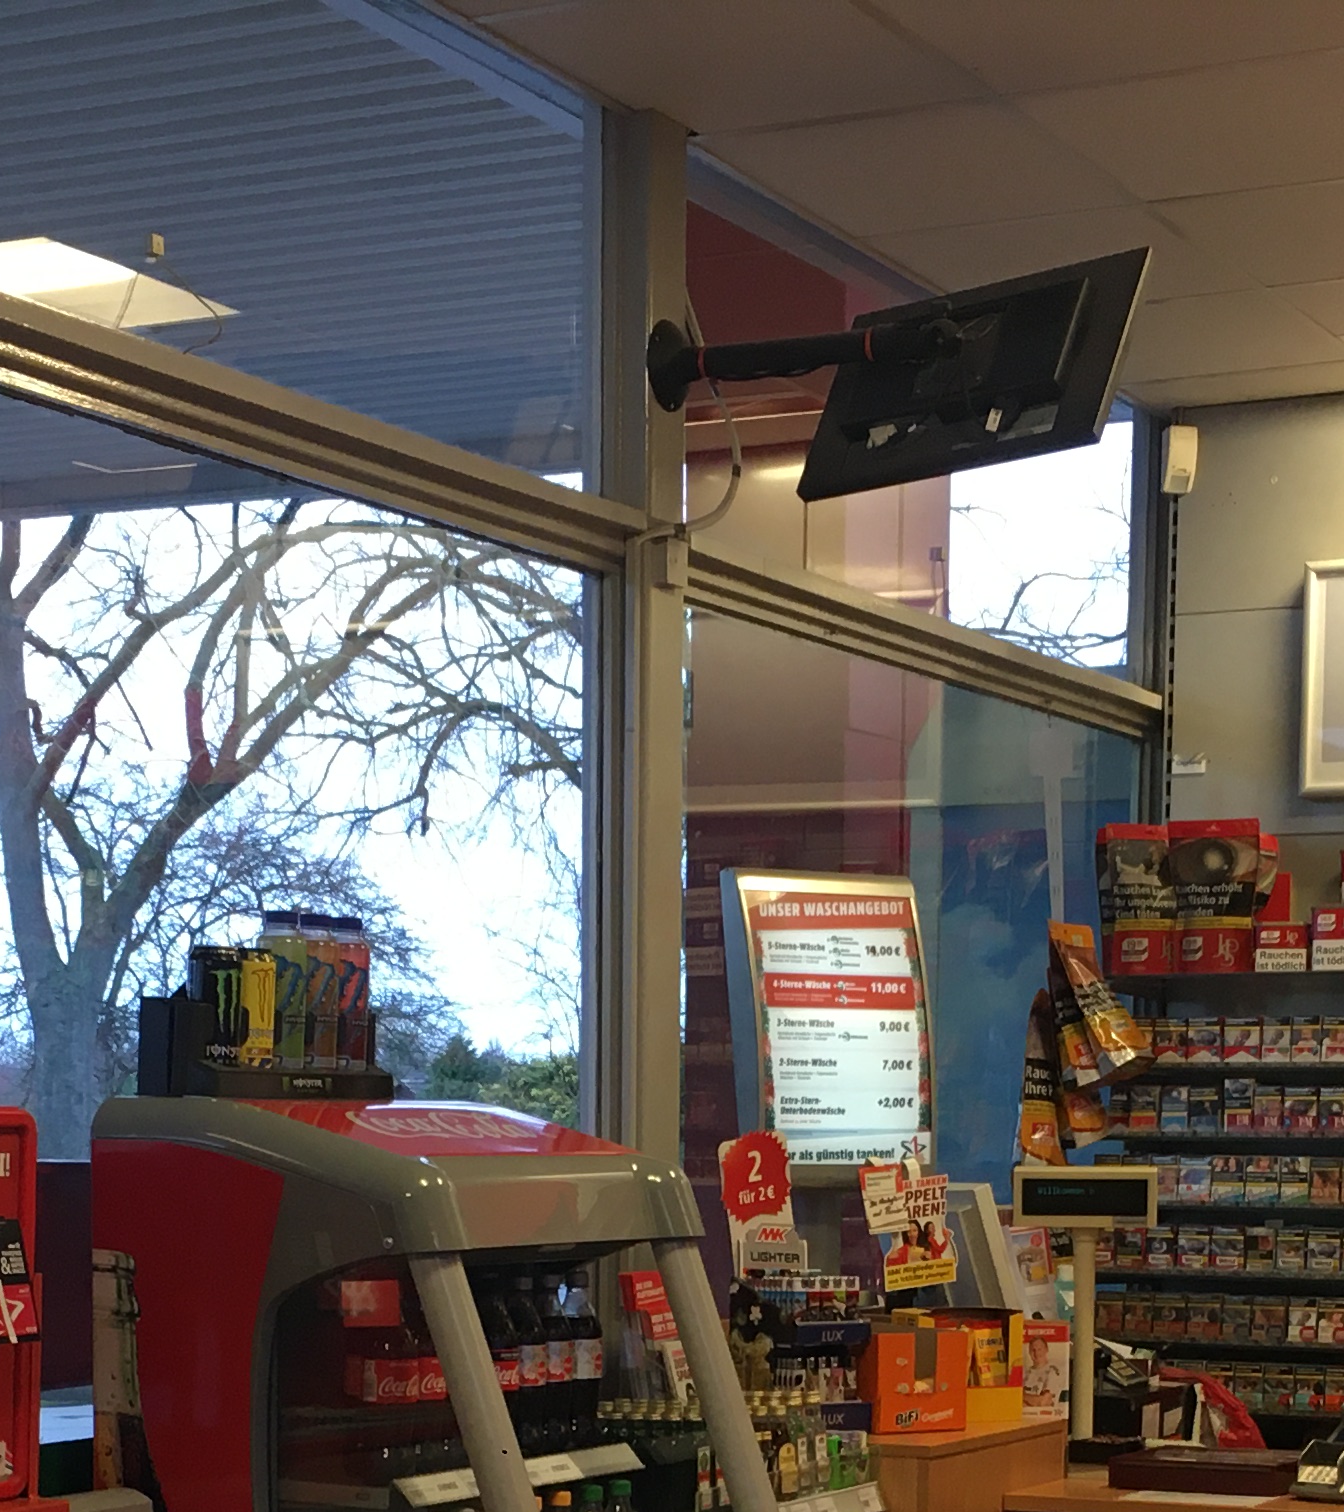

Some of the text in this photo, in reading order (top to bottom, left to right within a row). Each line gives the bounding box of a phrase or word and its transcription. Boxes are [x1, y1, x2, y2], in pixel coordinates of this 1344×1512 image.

[759, 902, 904, 916] UNSER WASCHANGEBOT
[768, 941, 826, 952] 5-Sterne-Wäsche
[1260, 951, 1303, 960] Rauchen
[1272, 961, 1306, 970] tödlich
[773, 980, 898, 994] 4-Sterne-Wäsche 11,00
[776, 1018, 902, 1033] 3-Sterne-Wäsche 9,00
[778, 1058, 904, 1071] 2-Sterne-Wäsche 7,00
[780, 1096, 906, 1109] Extra-Stern- +2,00
[780, 1106, 846, 1116] Unterbodenwäsche
[799, 1150, 814, 1161] als
[816, 1148, 854, 1162] günstig
[856, 1148, 895, 1160] tanken!
[747, 1151, 762, 1183] 2
[916, 1177, 947, 1187] TANKEN
[739, 1190, 755, 1205] für
[750, 1252, 800, 1263] LIGHTER
[822, 1330, 844, 1342] LUX
